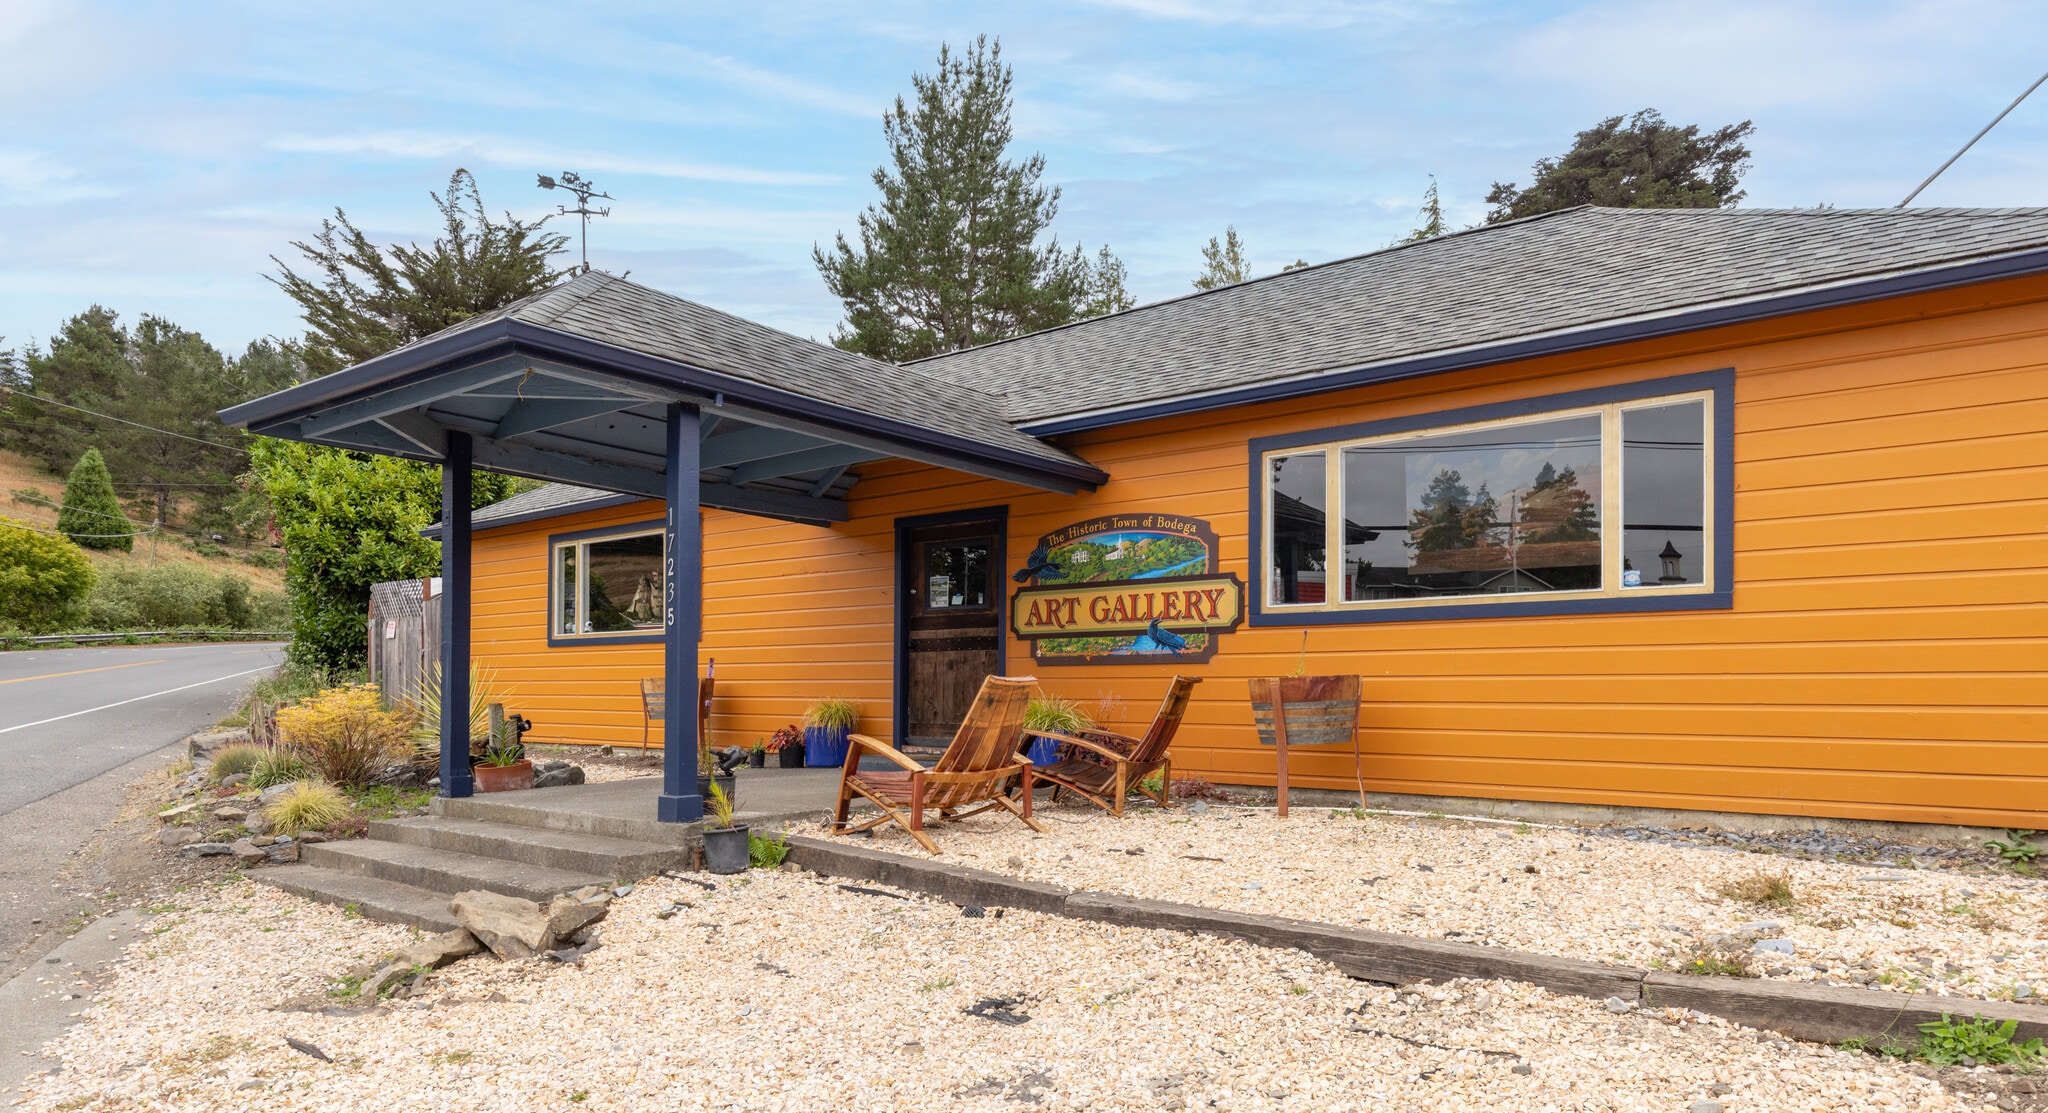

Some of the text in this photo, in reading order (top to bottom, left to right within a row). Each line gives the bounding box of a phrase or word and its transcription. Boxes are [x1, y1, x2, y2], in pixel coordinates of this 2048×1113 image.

[1048, 516, 1197, 546] The Historic Town of Bodega
[1025, 588, 1225, 628] ART GALLERY
